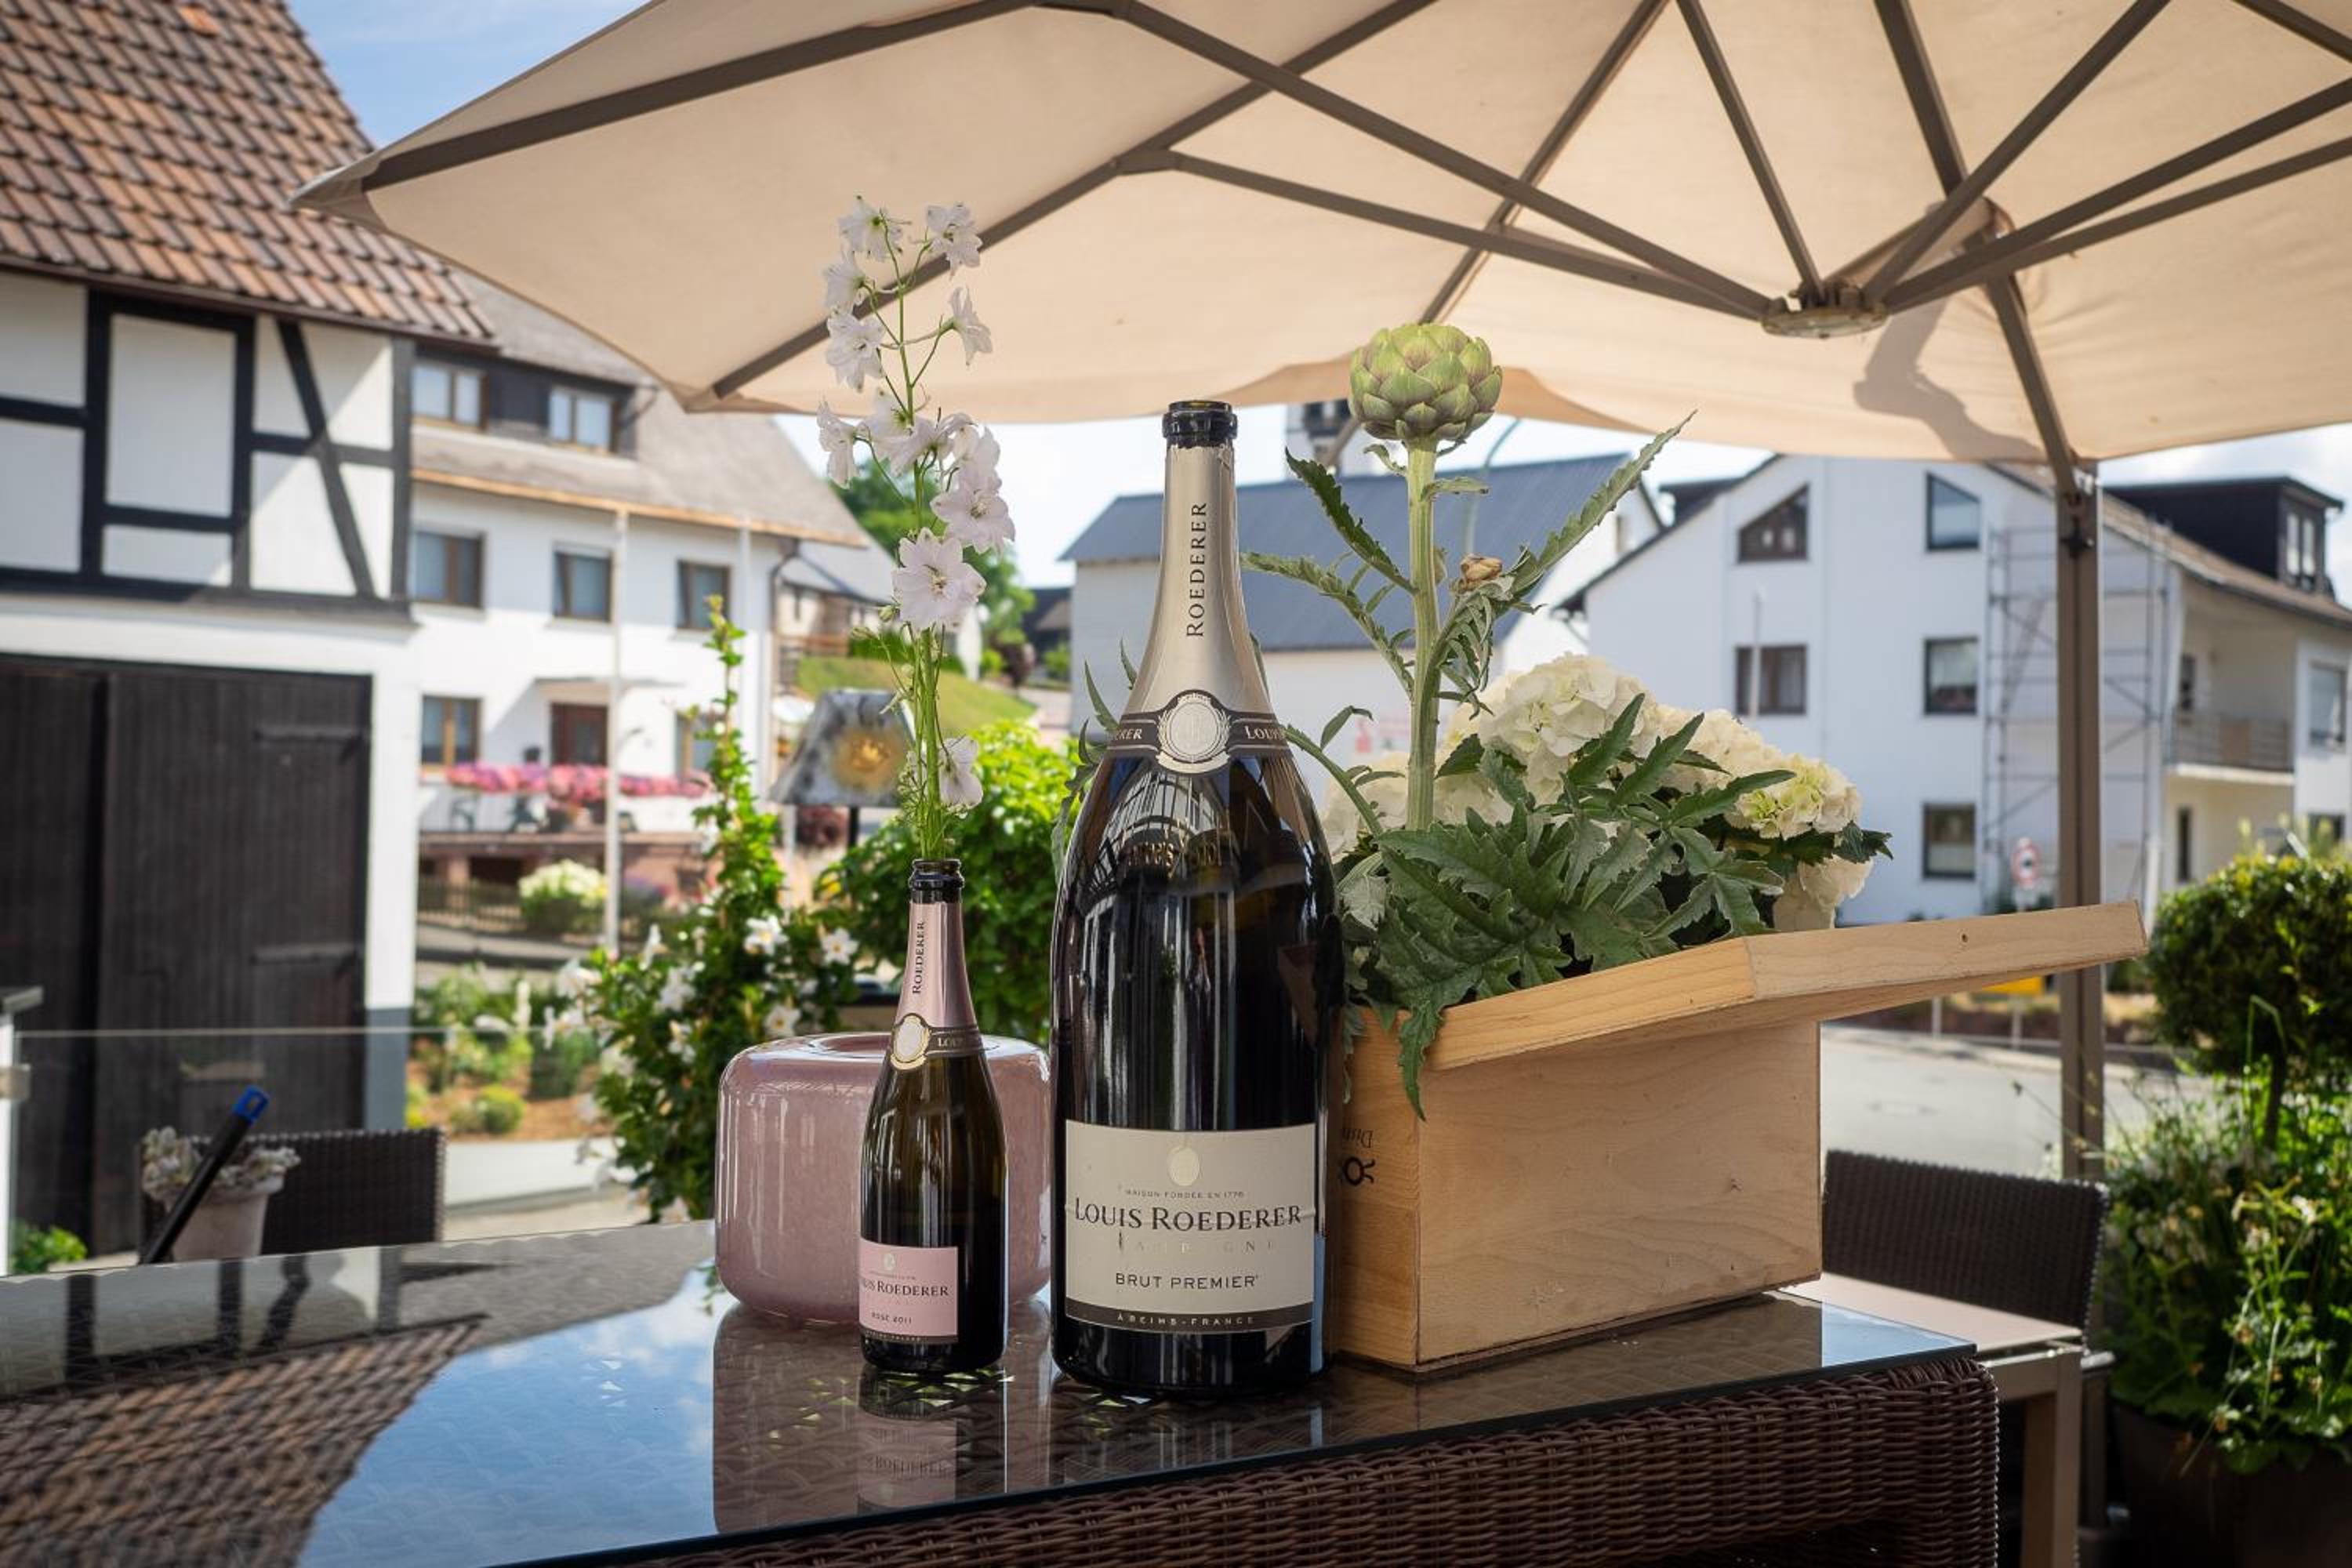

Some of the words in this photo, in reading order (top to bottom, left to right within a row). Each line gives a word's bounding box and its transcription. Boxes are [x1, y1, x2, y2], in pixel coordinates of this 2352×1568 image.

[1186, 502, 1207, 637] ROEDERER
[912, 921, 926, 994] ROEDERER
[1075, 1198, 1142, 1229] LOUIS
[1152, 1205, 1301, 1232] ROEDERER
[877, 1280, 949, 1297] ROEDERER
[1116, 1272, 1162, 1287] BRUT
[1170, 1275, 1255, 1290] PREMIER
